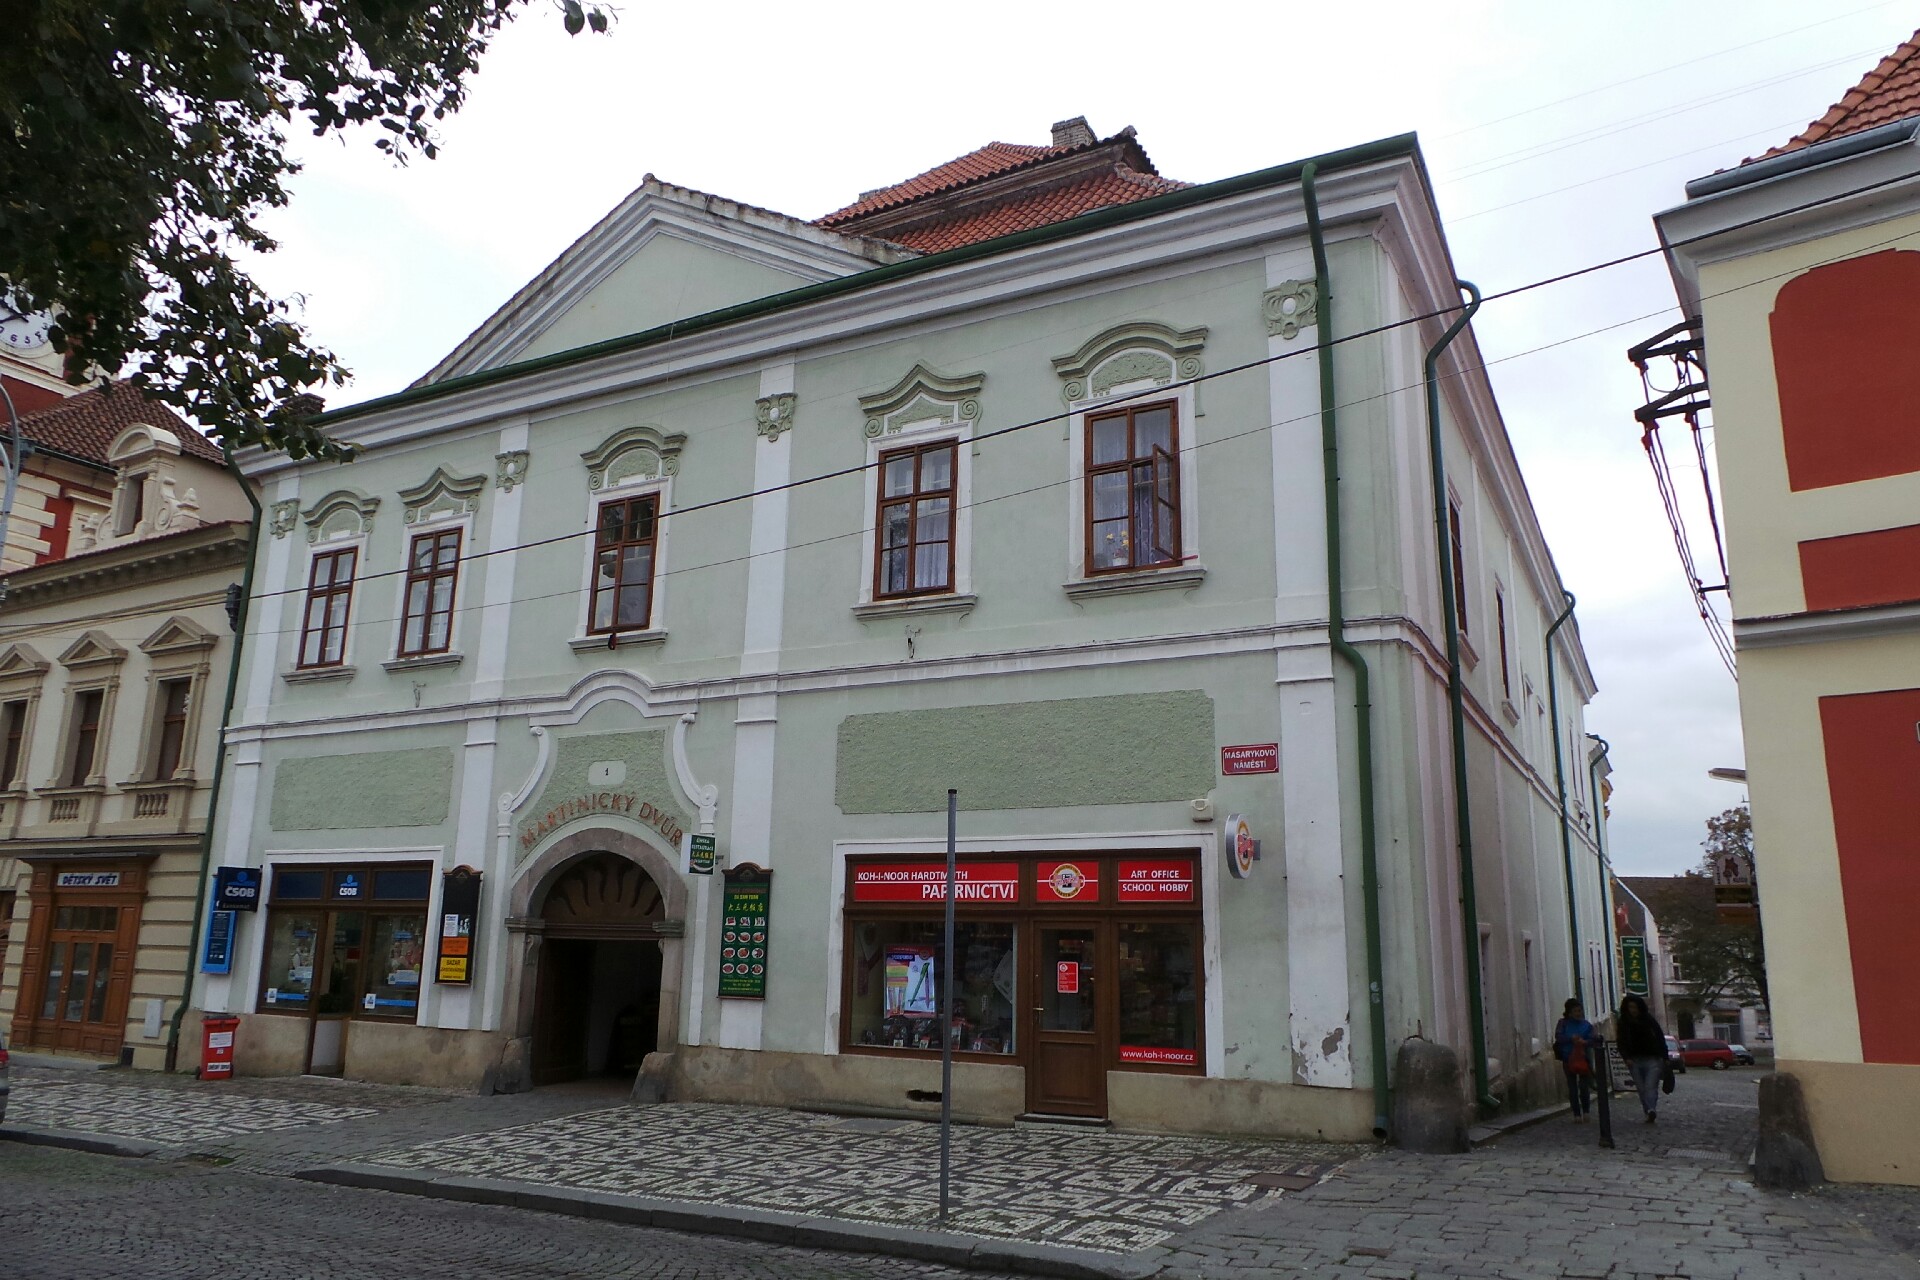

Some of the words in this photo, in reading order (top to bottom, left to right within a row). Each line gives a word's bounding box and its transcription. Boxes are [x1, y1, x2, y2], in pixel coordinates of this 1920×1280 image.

[10, 333, 18, 342] 6
[25, 335, 31, 344] 5
[1224, 749, 1276, 759] MASARYKOVO
[1233, 759, 1267, 769] NÁMĚSTÍ
[605, 767, 609, 776] 1
[520, 791, 636, 848] MARTINICKÝ
[638, 801, 684, 846] DVŮR
[95, 873, 117, 885] SVĚT
[858, 871, 909, 881] KOH-I-NOOR
[911, 871, 968, 880] HARDTMTH
[1130, 870, 1147, 878] ART
[1151, 870, 1179, 878] OFFICE
[225, 885, 255, 897] ČSOB
[922, 880, 1014, 899] PAPRNICTVÍ
[1122, 883, 1155, 892] SCHOOL
[1159, 884, 1188, 892] HOBBY
[1122, 1050, 1194, 1061] www.koh-i-noor.cz
